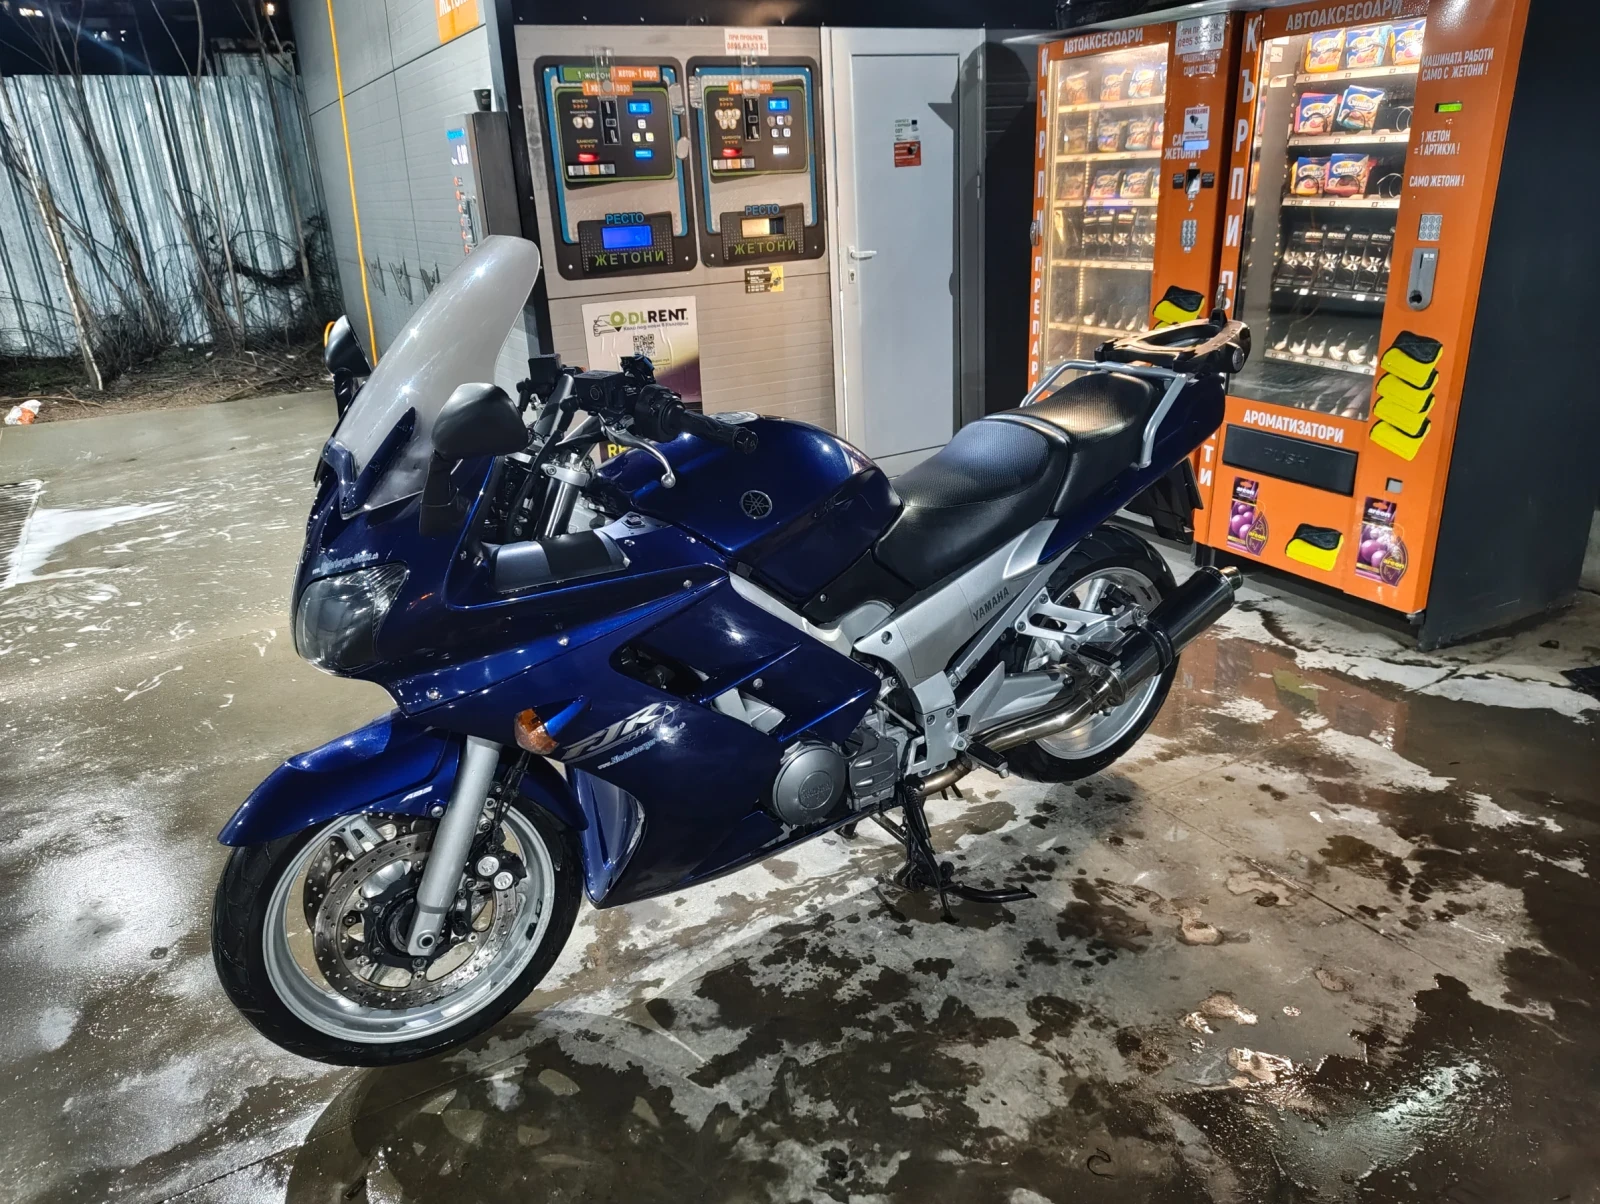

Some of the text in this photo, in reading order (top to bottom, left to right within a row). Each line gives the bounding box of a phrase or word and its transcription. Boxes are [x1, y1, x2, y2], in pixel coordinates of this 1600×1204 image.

[1285, 0, 1403, 31] АВТОАКСЕСОАРИ
[1063, 27, 1144, 55] АВТОАКСЕСОАРИ
[1421, 47, 1495, 67] МАШИНАТА РАБОТИ
[1422, 67, 1442, 82] САМО
[1443, 66, 1449, 79] С
[1451, 63, 1484, 78] ЖЕТОНИ
[1421, 129, 1451, 142] 1 ЖЕТОН
[1424, 144, 1456, 156] АРТИКУЛ
[1409, 175, 1429, 187] САМО
[1430, 175, 1461, 187] ЖЕТОНИ
[745, 204, 780, 216] РЕСТО
[605, 212, 645, 225] РЕСТО
[734, 240, 796, 255] ЖЕТОНИ
[595, 250, 665, 266] ЖЕТОНИ
[1243, 409, 1344, 444] АРОМАТИЗАТОРИ
[1236, 486, 1255, 496] areon
[1367, 507, 1391, 518] areon
[1248, 531, 1266, 540] areon
[1383, 558, 1405, 569] areon
[972, 586, 1010, 621] YAMAHA
